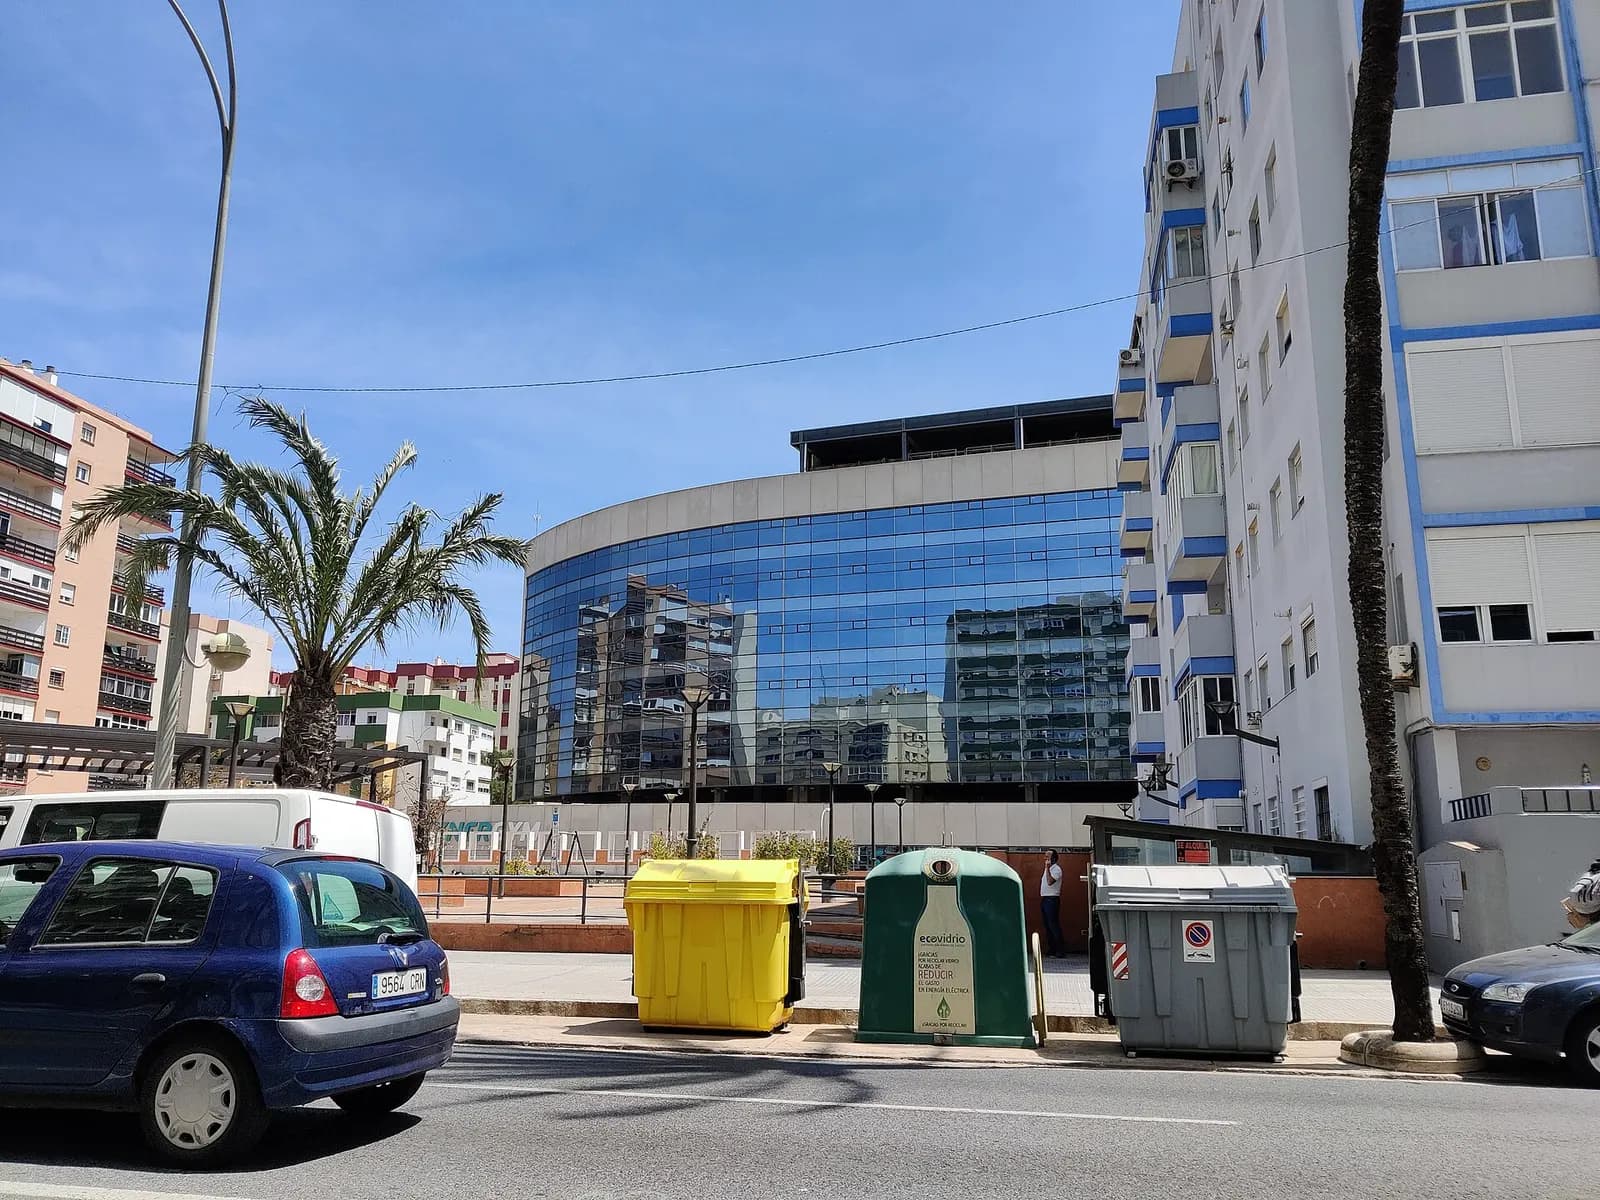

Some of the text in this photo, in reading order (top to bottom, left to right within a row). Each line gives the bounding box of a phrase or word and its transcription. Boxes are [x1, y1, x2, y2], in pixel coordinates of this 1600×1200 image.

[1185, 841, 1209, 849] ALQUILA
[919, 933, 966, 944] ecovidrio
[918, 970, 953, 980] REDUCIR
[381, 972, 425, 994] 9564 CRN
